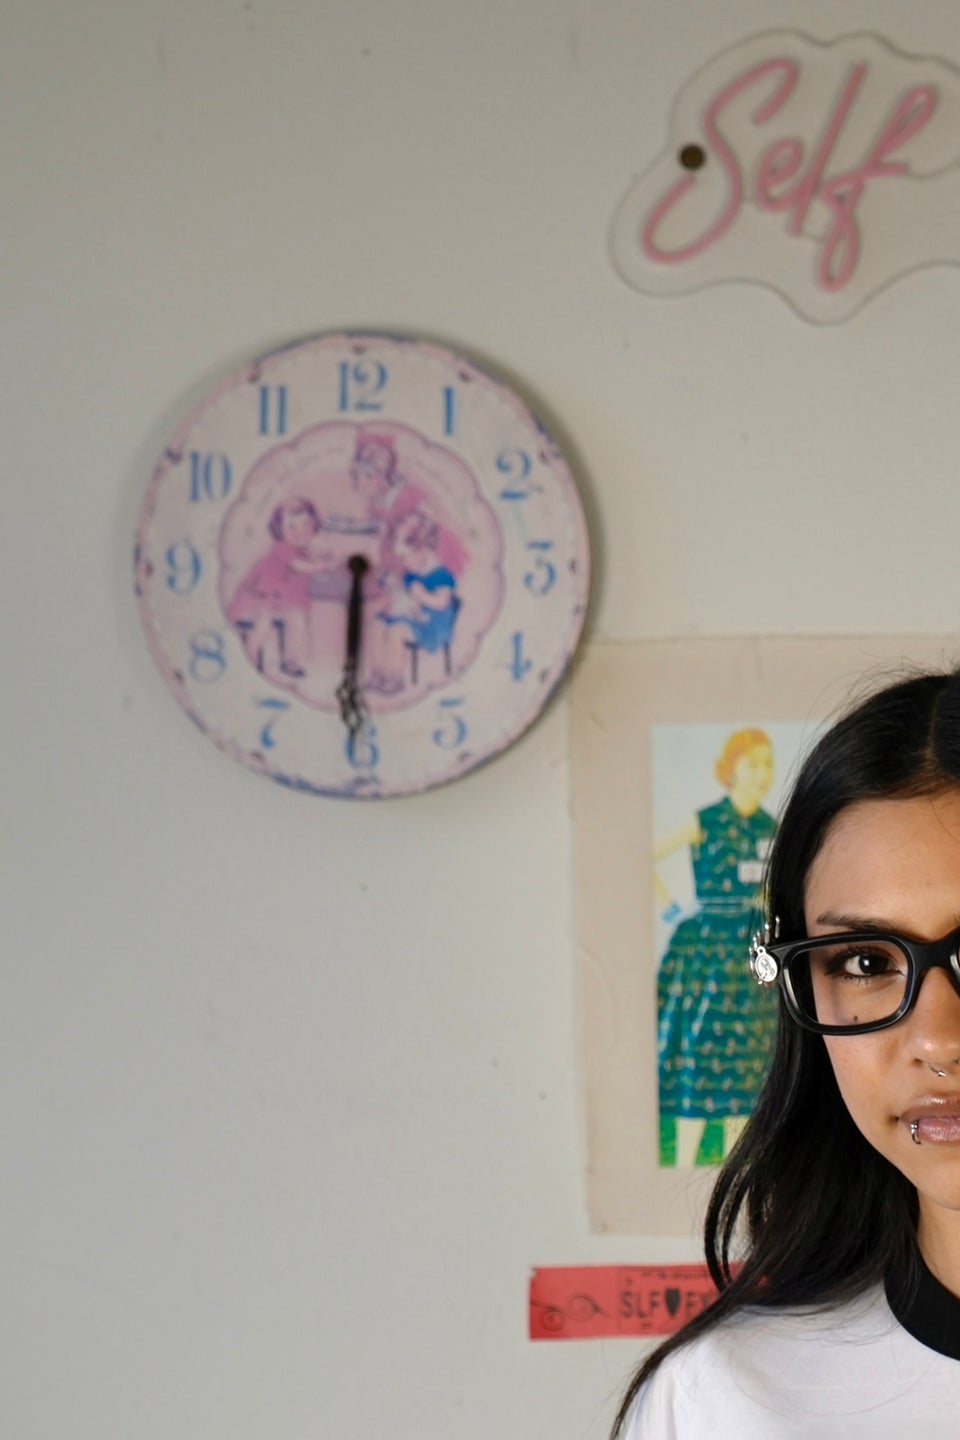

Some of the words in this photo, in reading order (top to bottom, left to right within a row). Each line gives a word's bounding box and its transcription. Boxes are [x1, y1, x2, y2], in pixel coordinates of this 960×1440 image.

[642, 56, 938, 292] Self
[258, 385, 288, 436] 11
[340, 360, 388, 412] 12
[443, 385, 455, 436] 1
[190, 451, 232, 502] 10
[496, 449, 531, 500] 2
[165, 538, 202, 595] 9
[188, 630, 227, 684] 8
[254, 697, 291, 750] 7
[432, 697, 467, 750] 5
